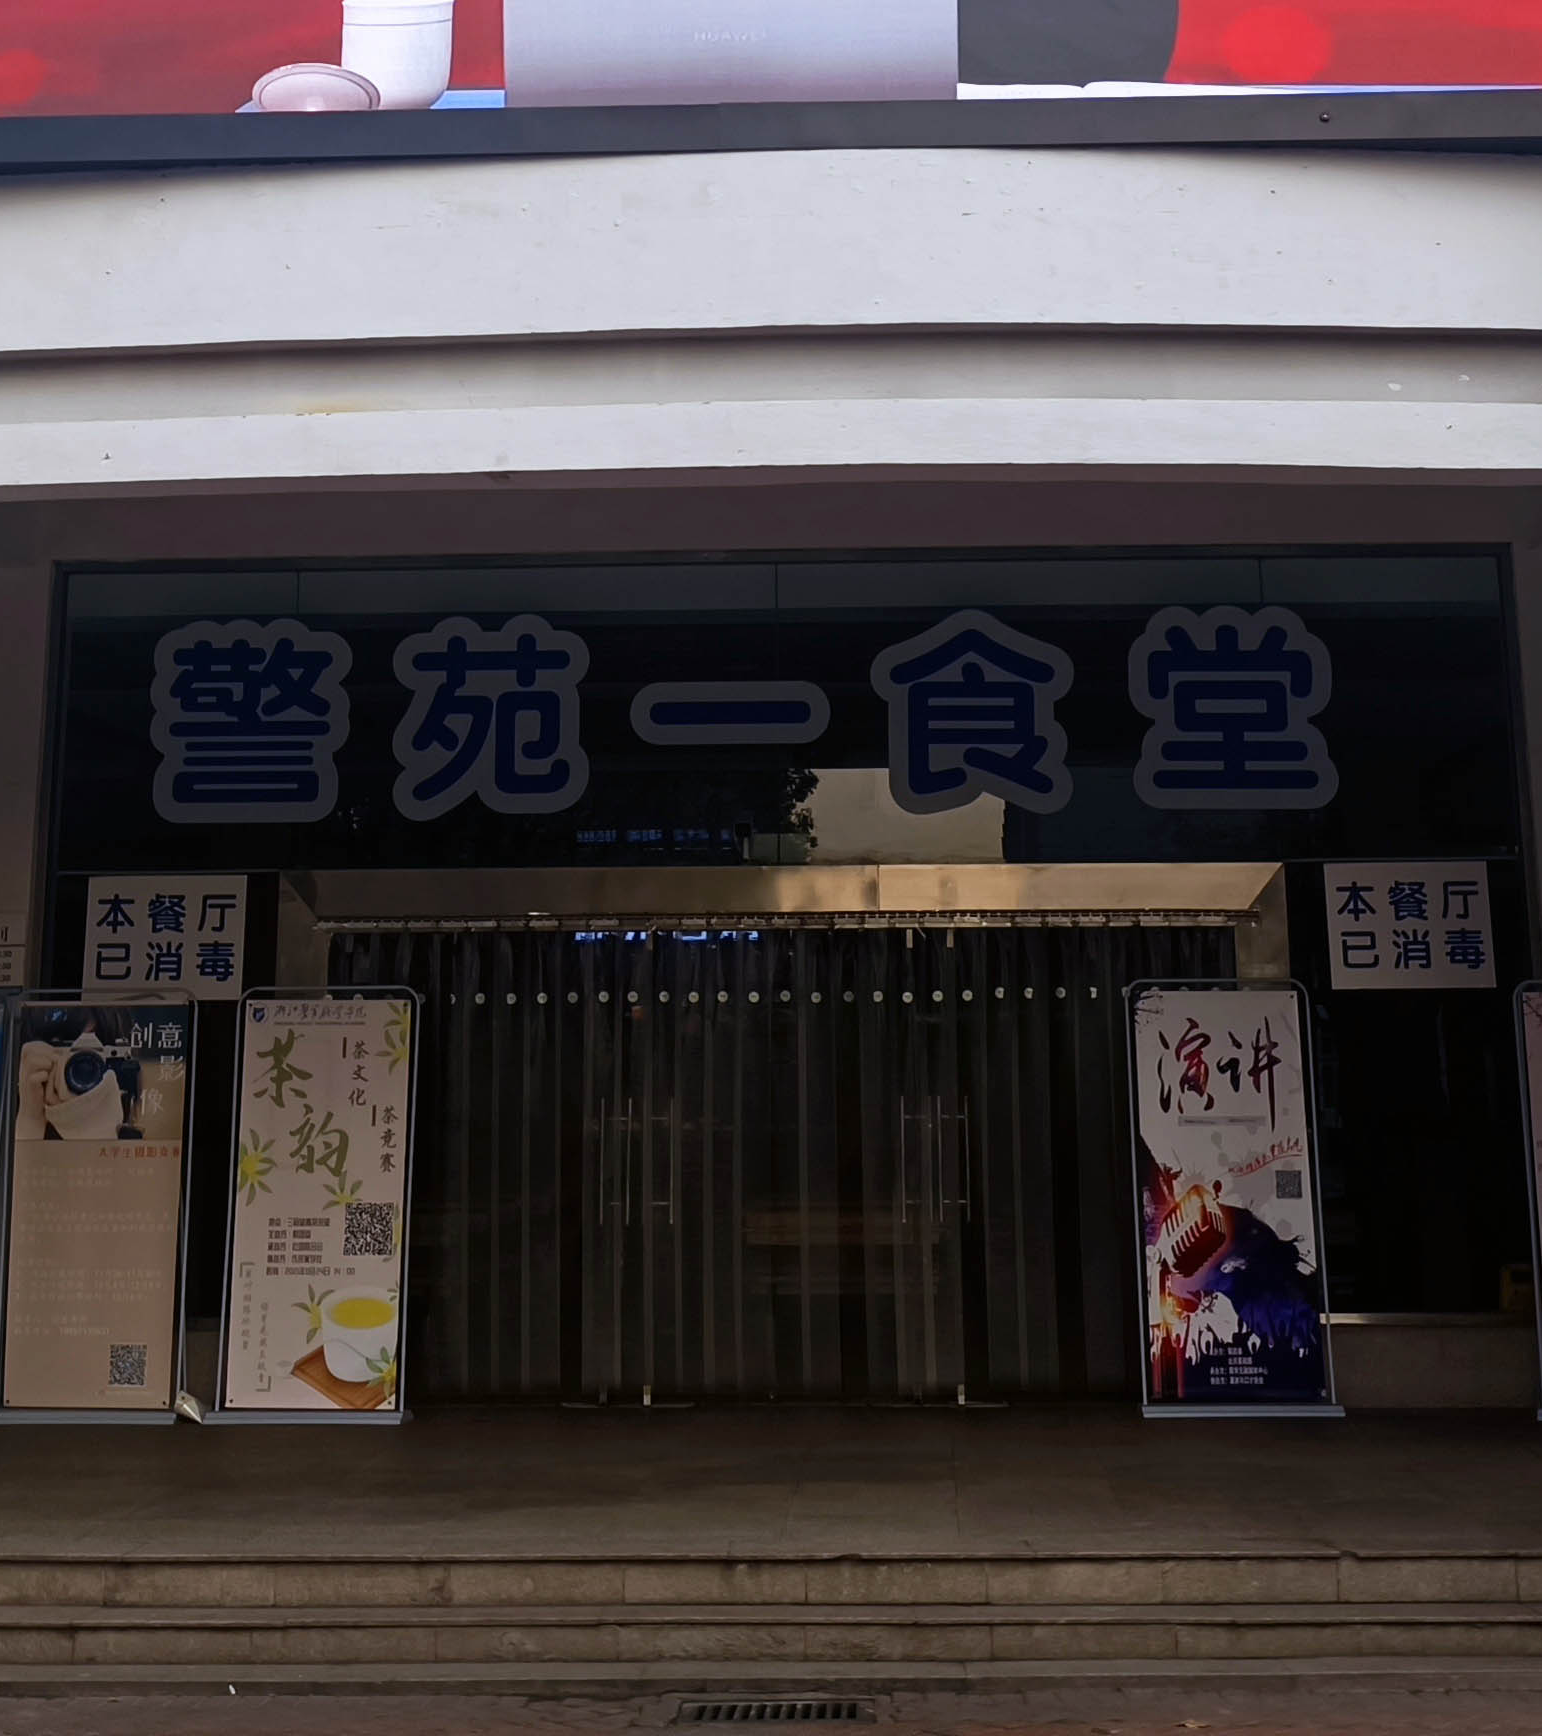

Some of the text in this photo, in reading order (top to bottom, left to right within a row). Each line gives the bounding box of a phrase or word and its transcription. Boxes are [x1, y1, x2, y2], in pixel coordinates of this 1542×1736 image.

[159, 616, 1329, 814] 警苑一食堂
[96, 893, 237, 934] 本餐厅
[1336, 881, 1479, 922] 本餐厅
[95, 940, 235, 982] 已消毒
[1340, 928, 1486, 969] 已消毒
[130, 1022, 184, 1050] 创意
[347, 1040, 370, 1107] 茶文化
[1157, 1016, 1282, 1133] 演讲
[379, 1105, 399, 1173] 茶竞赛
